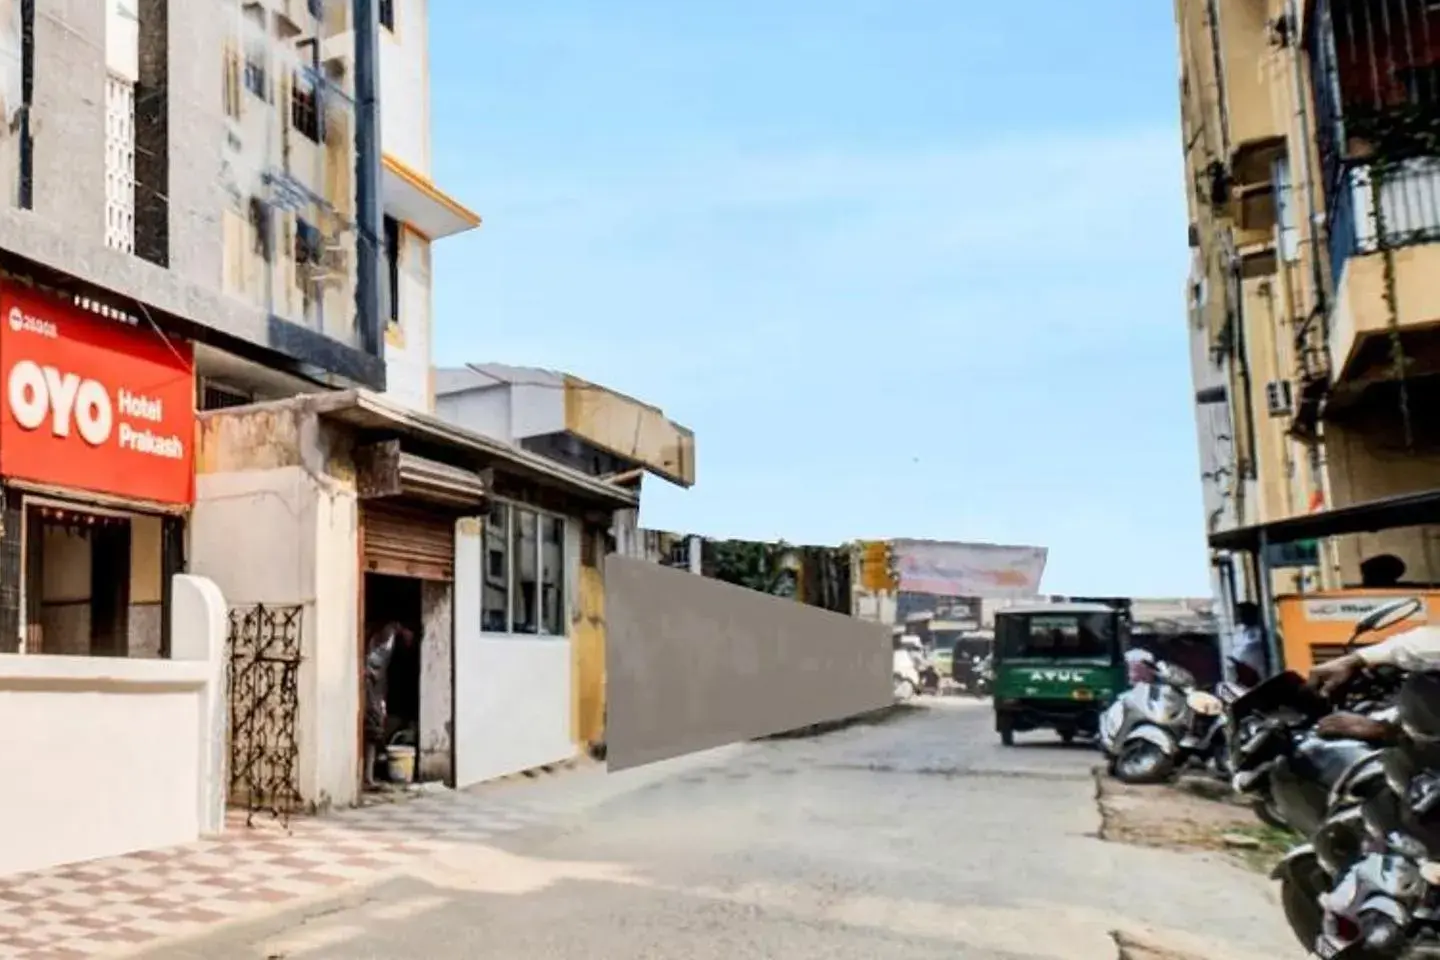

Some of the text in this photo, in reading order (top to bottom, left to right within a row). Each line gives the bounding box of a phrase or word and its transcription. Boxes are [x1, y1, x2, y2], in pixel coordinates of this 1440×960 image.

[8, 360, 113, 445] OYO
[118, 388, 163, 423] Hotel
[119, 422, 183, 459] Prakash
